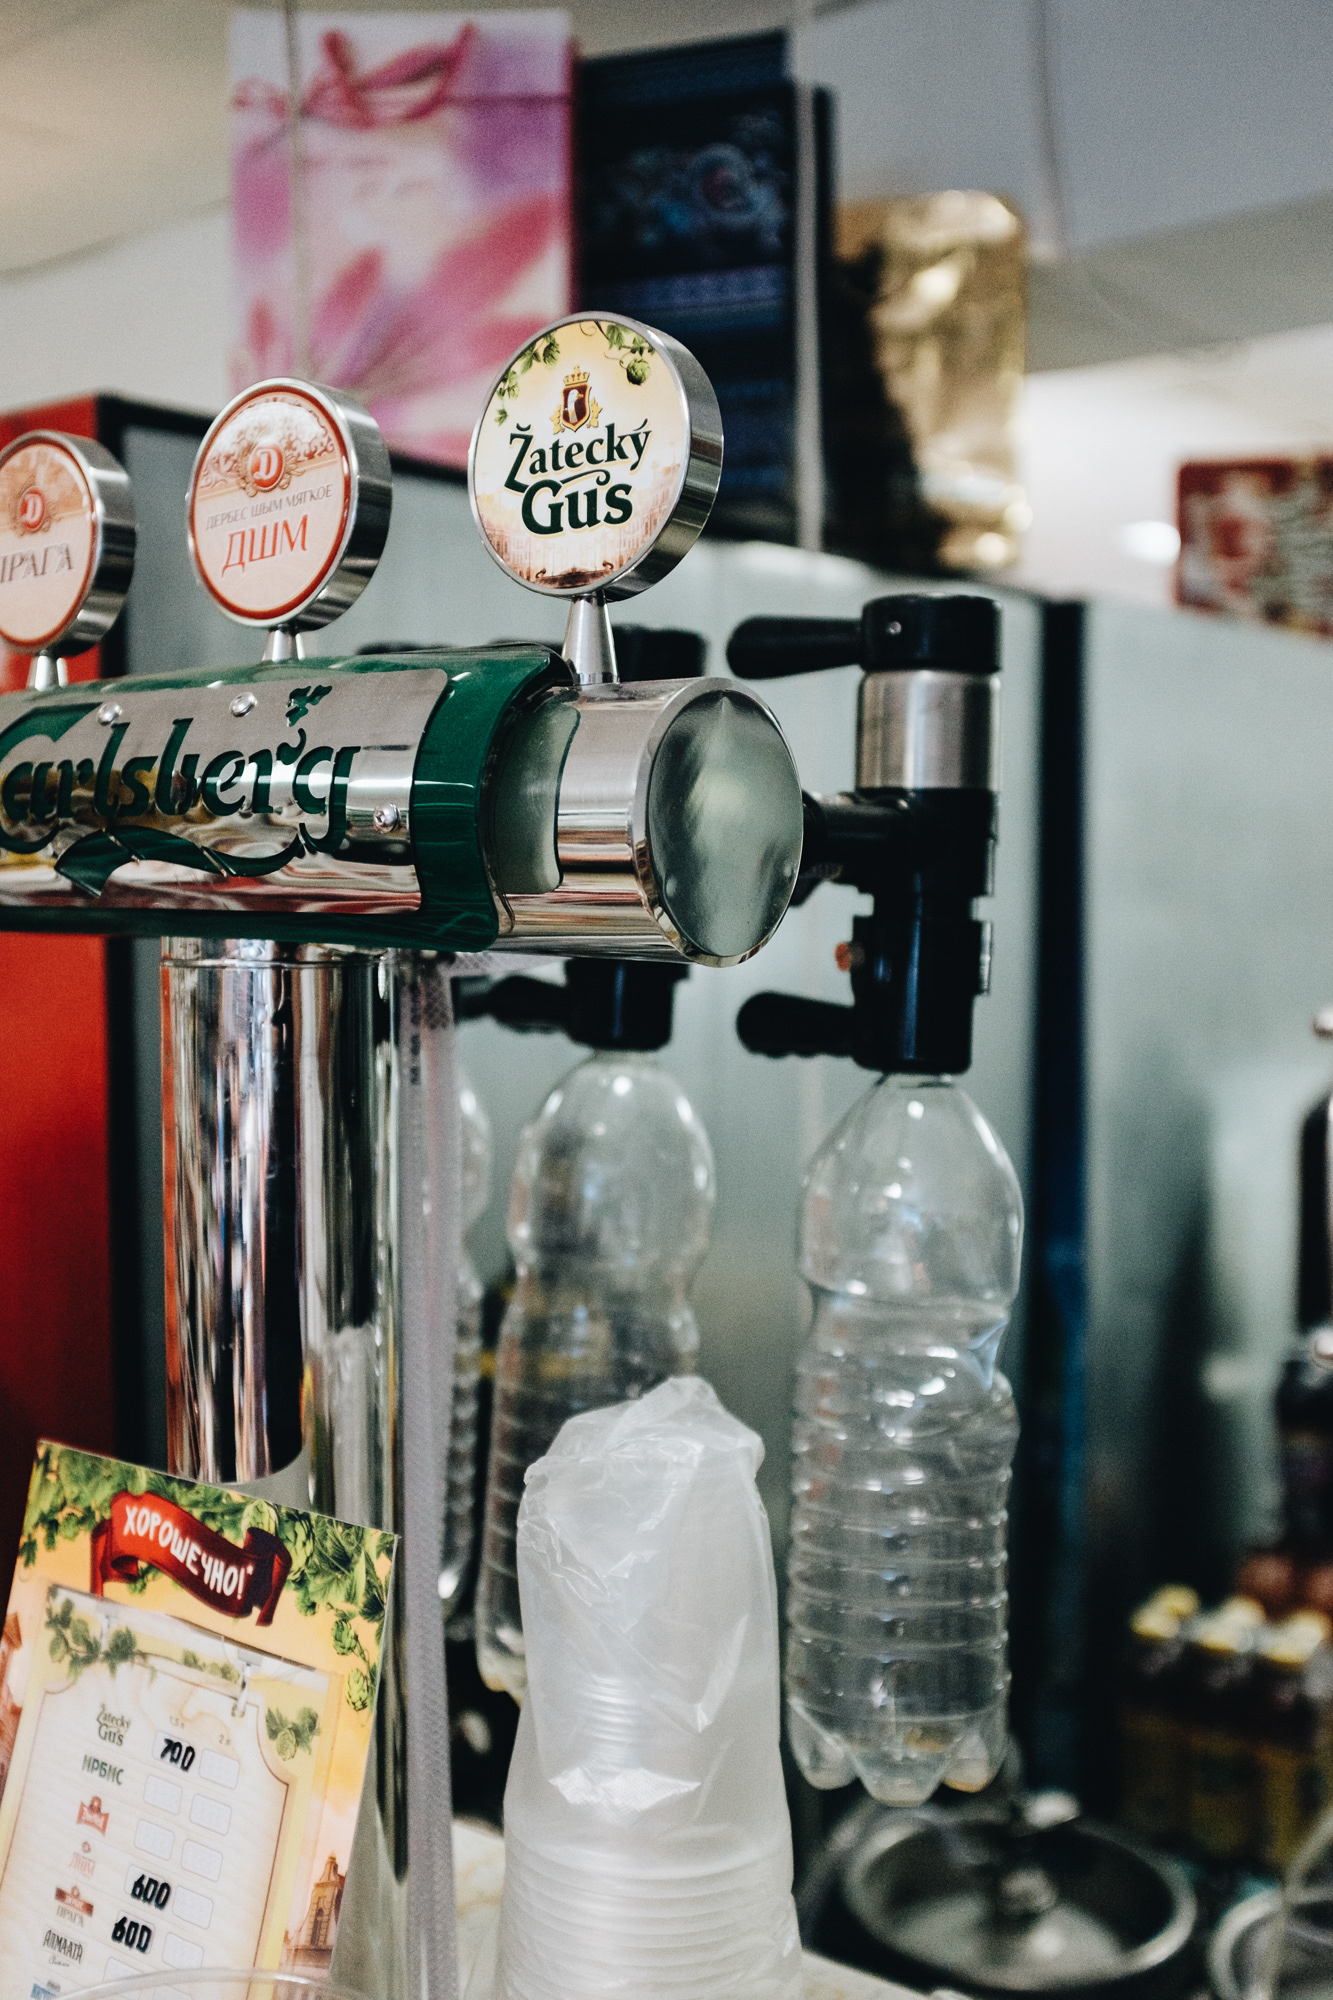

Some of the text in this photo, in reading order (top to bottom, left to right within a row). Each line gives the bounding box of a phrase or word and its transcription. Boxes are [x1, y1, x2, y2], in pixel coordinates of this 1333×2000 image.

[504, 418, 652, 493] Žatecký
[286, 483, 333, 507] МЯГКОЕ
[521, 479, 633, 535] Gus
[221, 514, 308, 578] ДШМ
[160, 1738, 195, 1772] 700
[130, 1874, 172, 1910] 600
[111, 1916, 153, 1953] 600
